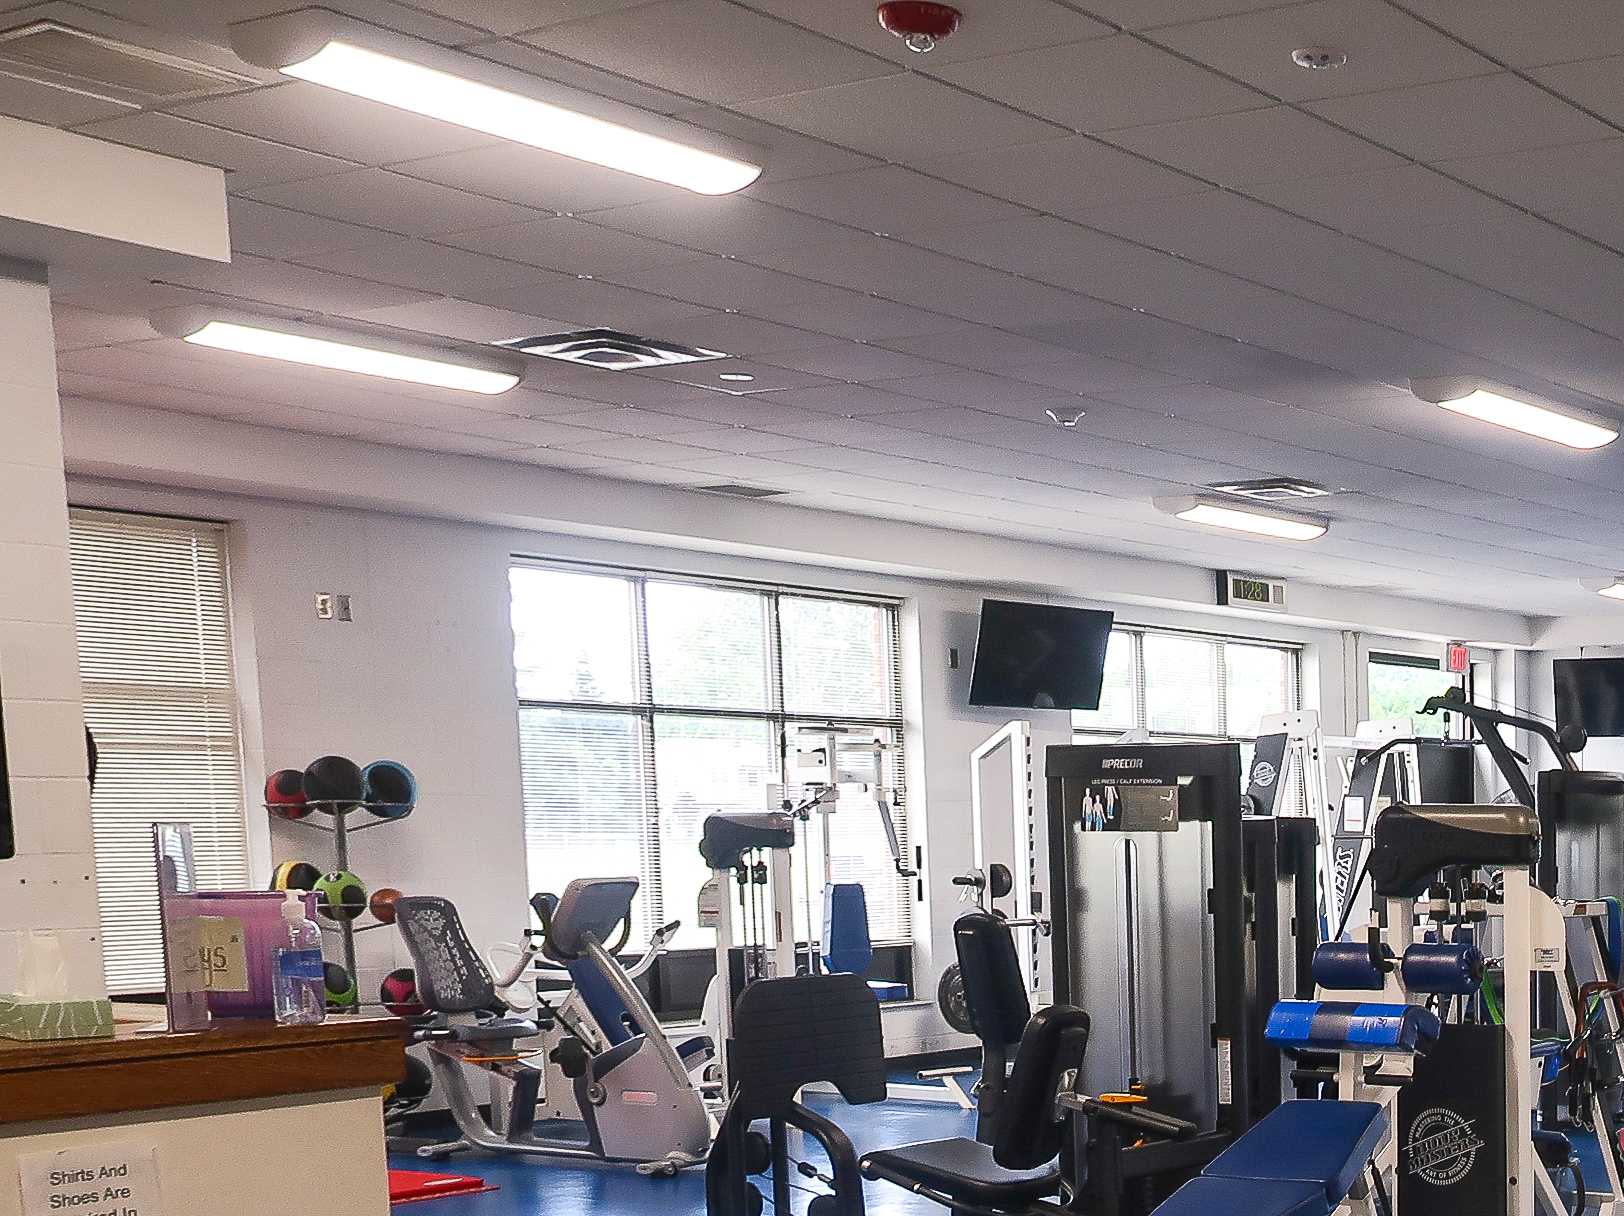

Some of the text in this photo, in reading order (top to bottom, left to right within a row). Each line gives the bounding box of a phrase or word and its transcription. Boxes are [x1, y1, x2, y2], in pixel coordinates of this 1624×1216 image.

[1103, 758, 1143, 769] PRECOR
[50, 1163, 128, 1186] Shirts And
[49, 1186, 131, 1209] Shoes Are
